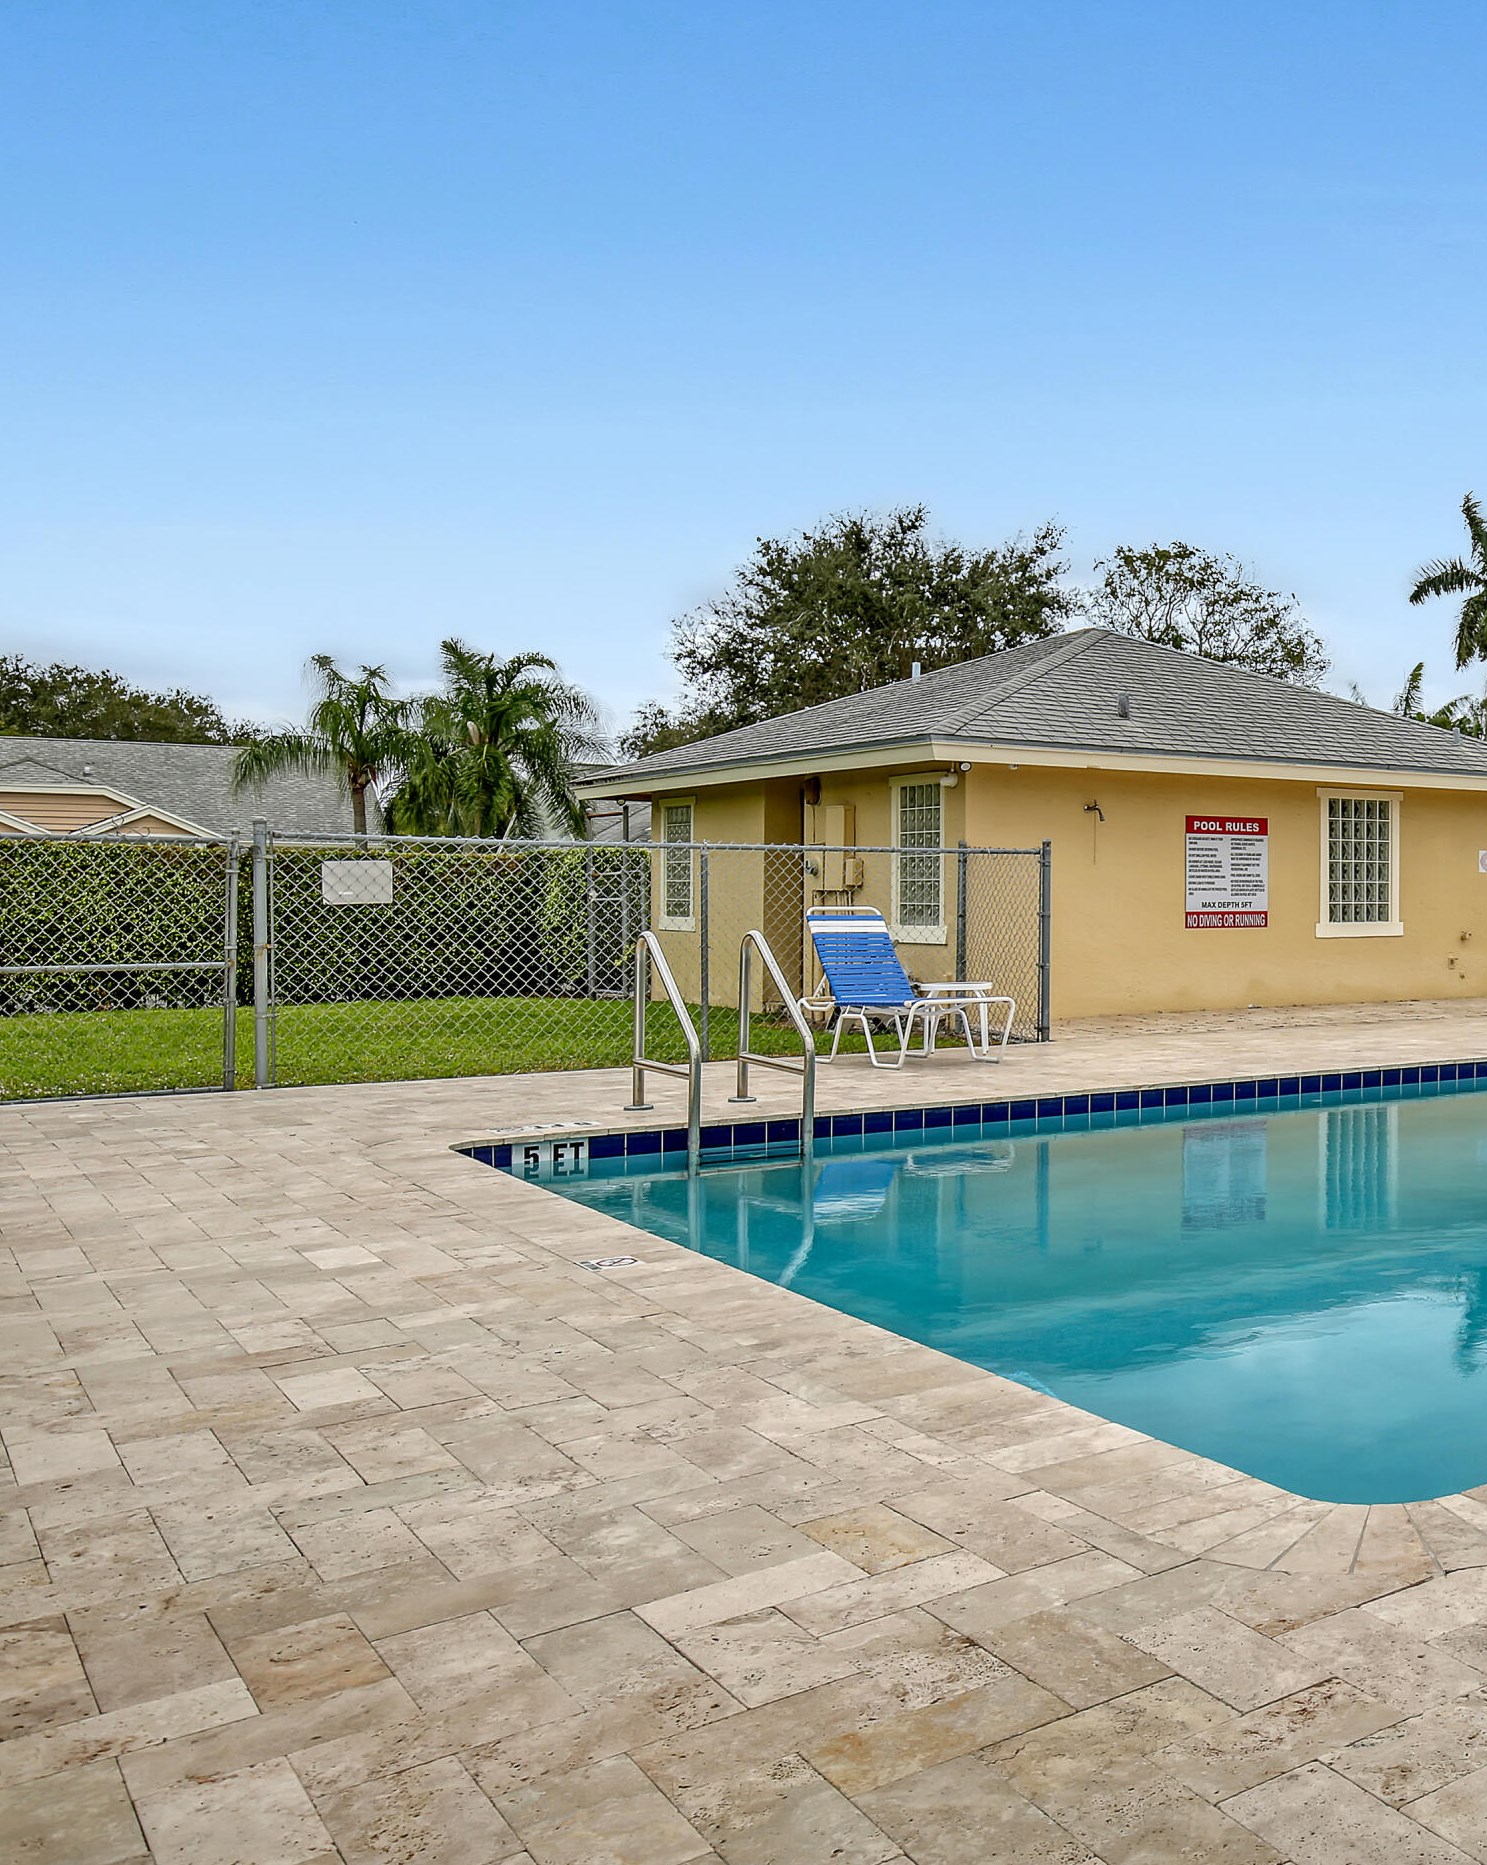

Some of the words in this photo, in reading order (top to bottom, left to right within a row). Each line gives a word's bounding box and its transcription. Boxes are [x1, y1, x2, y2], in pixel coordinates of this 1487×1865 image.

[1193, 821, 1223, 831] POOL
[1225, 822, 1260, 832] RULES
[1201, 901, 1217, 909] MAX
[1217, 901, 1240, 909] DEPTH
[1240, 901, 1253, 909] 5FT
[1187, 914, 1198, 927] NO
[1199, 914, 1223, 927] DIVING
[1223, 914, 1234, 927] OR
[1235, 914, 1266, 927] RUNNING
[524, 1145, 540, 1166] 5
